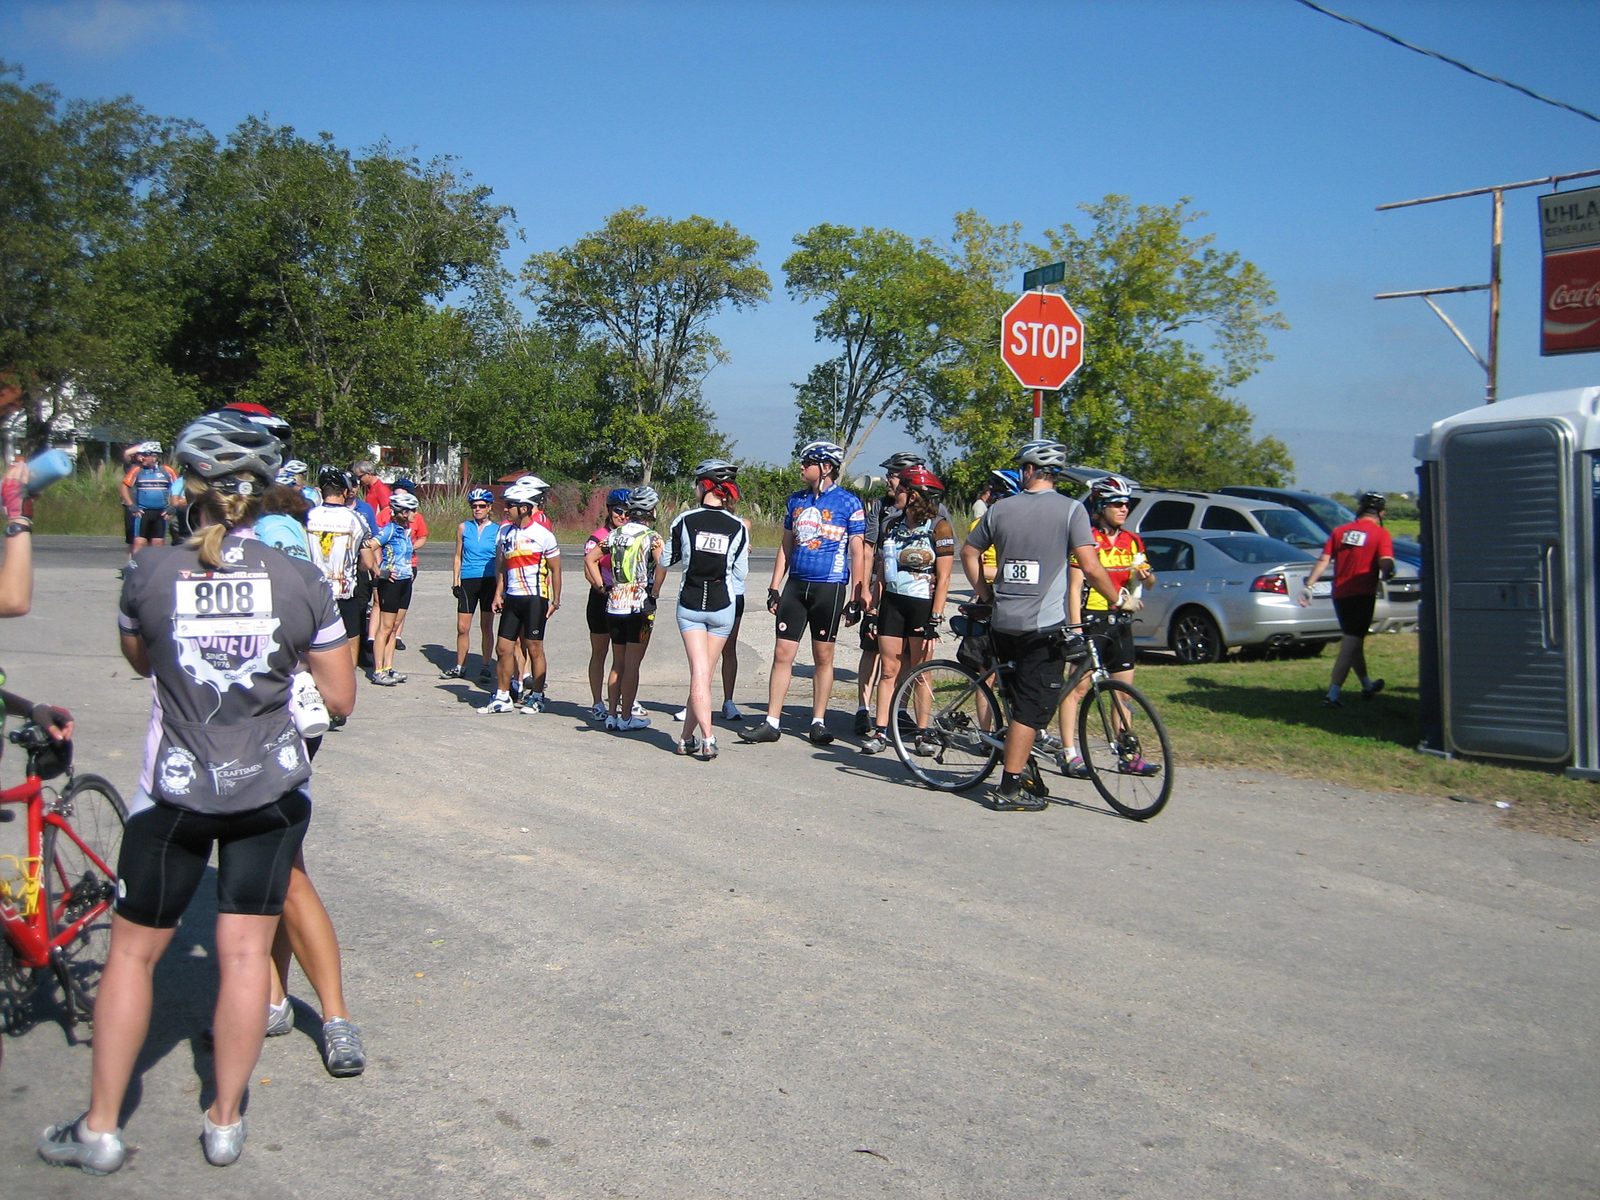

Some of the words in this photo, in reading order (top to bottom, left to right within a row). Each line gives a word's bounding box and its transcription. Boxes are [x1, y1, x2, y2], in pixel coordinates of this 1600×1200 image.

[1010, 320, 1078, 359] STOP
[702, 537, 722, 549] 761
[1012, 564, 1027, 579] 38
[195, 581, 254, 614] 808
[206, 652, 229, 661] SINCE
[212, 661, 231, 669] 1976
[217, 763, 262, 778] CRAFTSMEN
